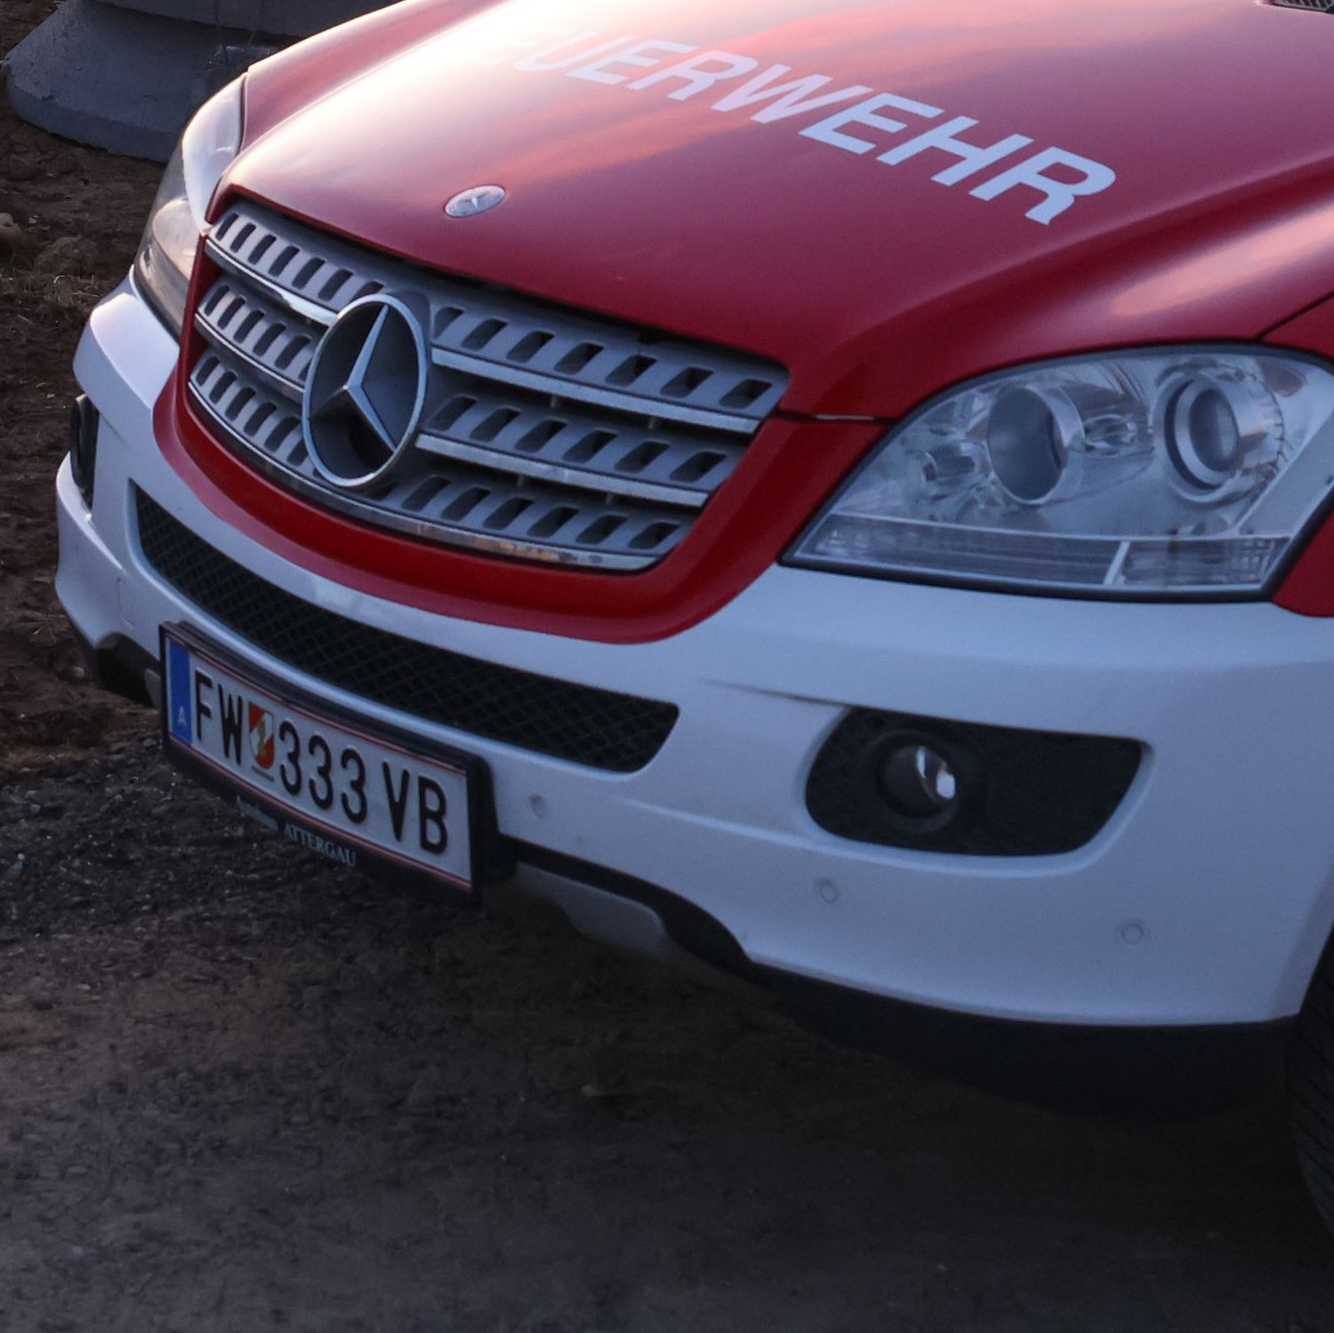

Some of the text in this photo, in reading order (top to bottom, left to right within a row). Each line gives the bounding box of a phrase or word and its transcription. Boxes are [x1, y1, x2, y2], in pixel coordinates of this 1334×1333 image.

[472, 28, 1117, 226] UERWEHR
[178, 707, 187, 727] A
[194, 669, 449, 855] FW 333 VB
